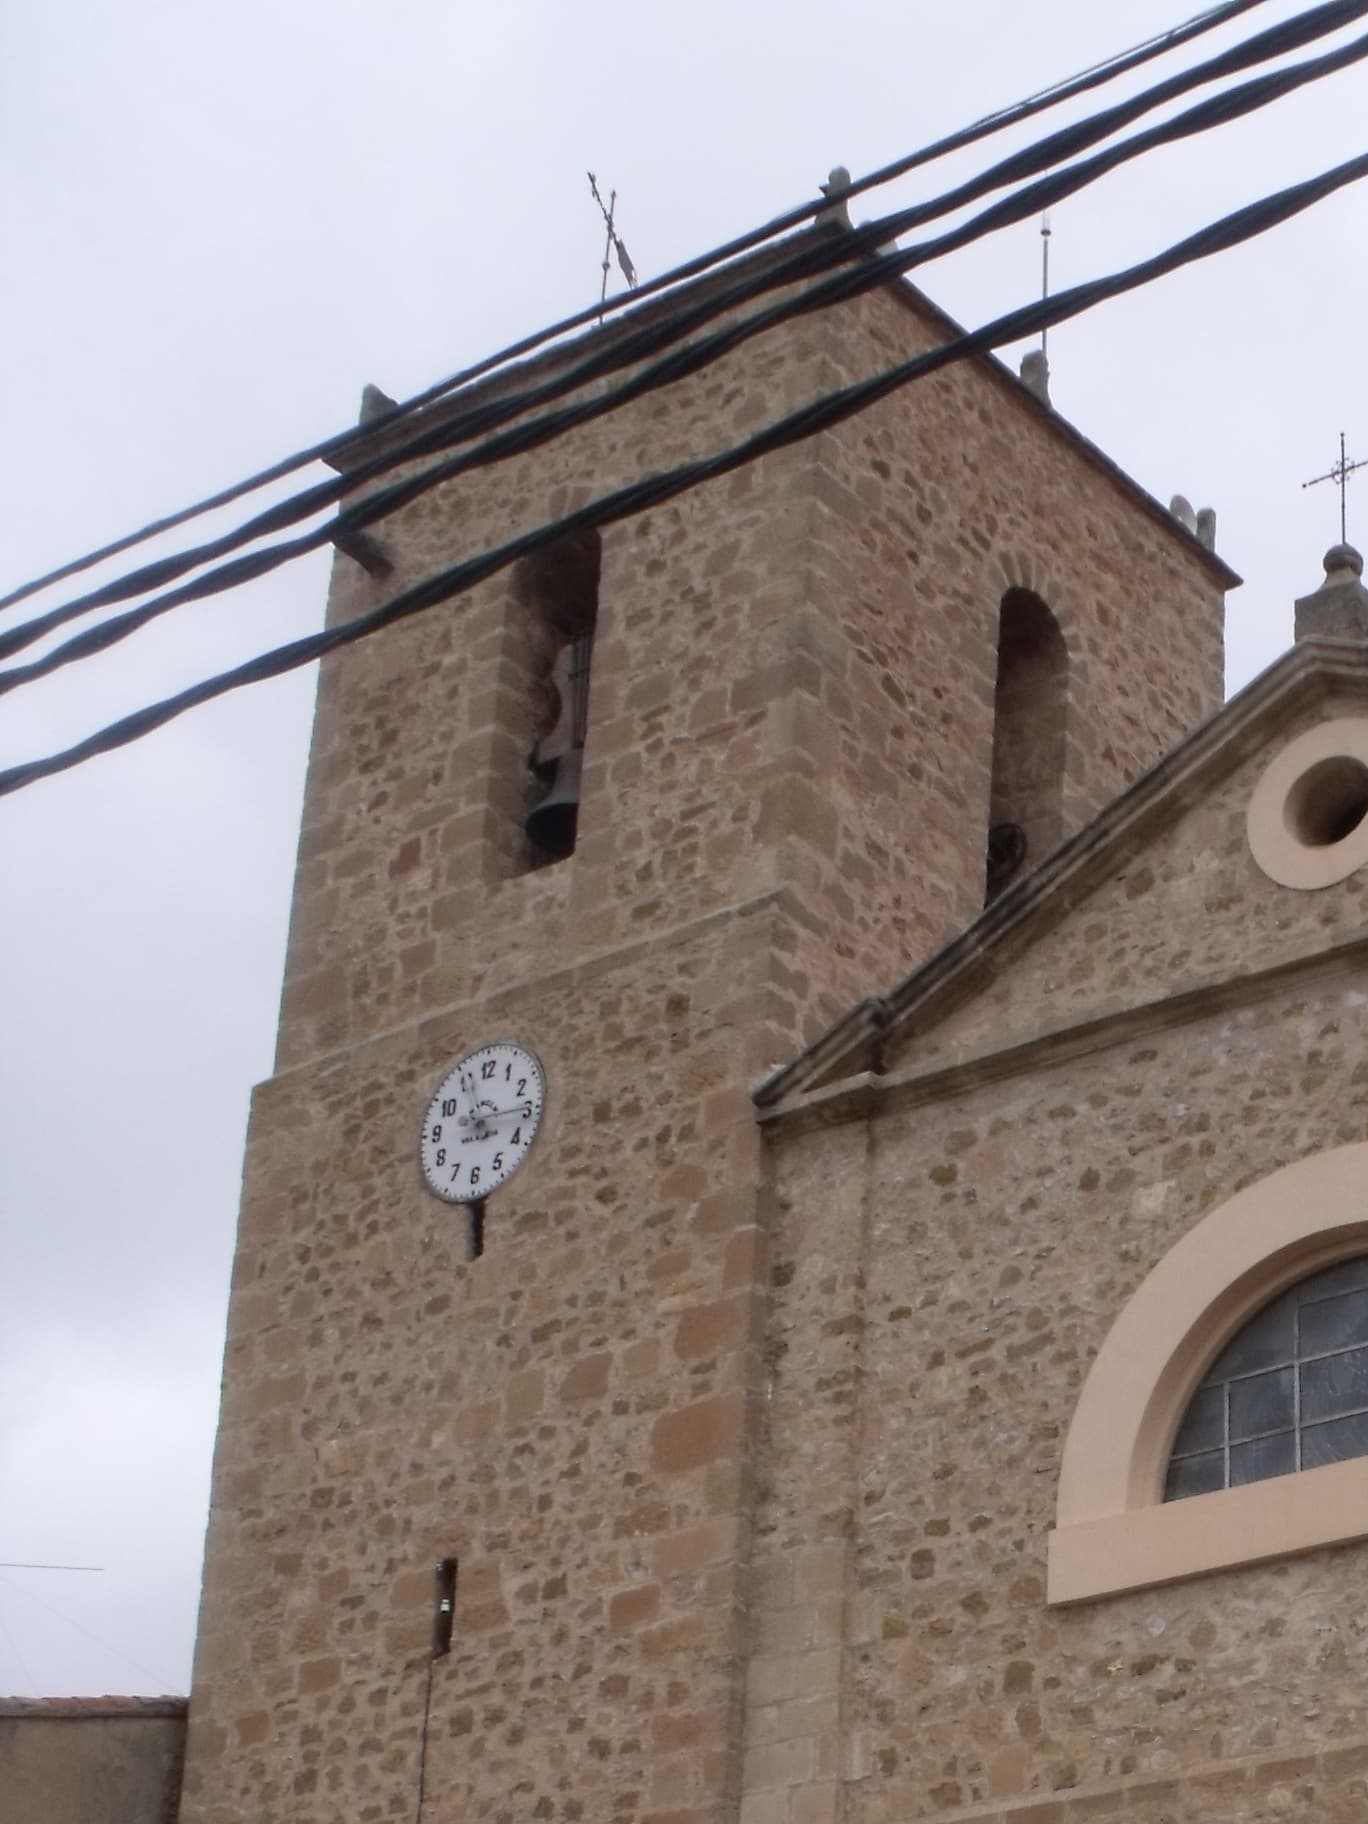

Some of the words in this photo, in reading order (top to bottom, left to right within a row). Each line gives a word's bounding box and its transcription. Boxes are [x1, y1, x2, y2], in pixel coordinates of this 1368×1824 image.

[481, 1060, 497, 1080] 12
[505, 1063, 512, 1081] 1
[516, 1078, 527, 1097] 2
[442, 1098, 457, 1118] 10
[522, 1100, 533, 1119] 3
[431, 1125, 442, 1143] 9
[510, 1127, 521, 1145] 4
[436, 1148, 447, 1167] 8
[492, 1152, 504, 1171] 5
[450, 1163, 461, 1182] 7
[470, 1166, 481, 1185] 6
